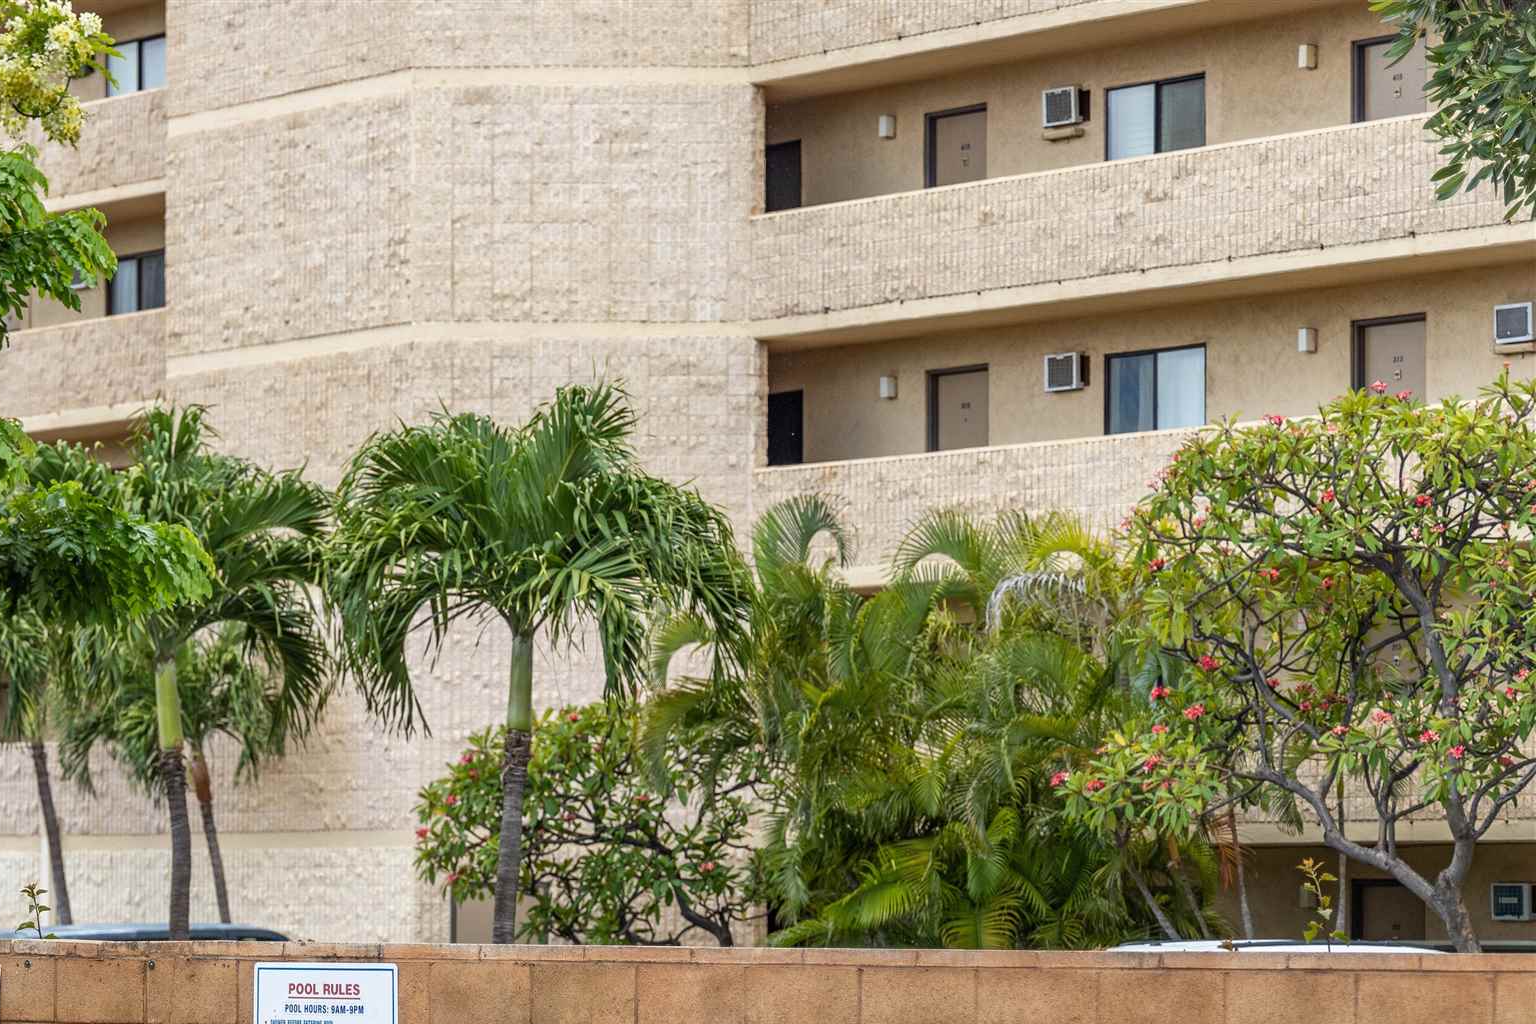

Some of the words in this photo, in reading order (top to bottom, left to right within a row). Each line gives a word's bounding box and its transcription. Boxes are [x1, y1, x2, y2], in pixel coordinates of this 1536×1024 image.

[288, 983, 319, 994] POOL
[323, 984, 360, 996] RULES
[284, 1004, 302, 1013] POOL
[304, 1004, 329, 1014] HOURS:
[330, 1005, 364, 1014] 9AM-9PM
